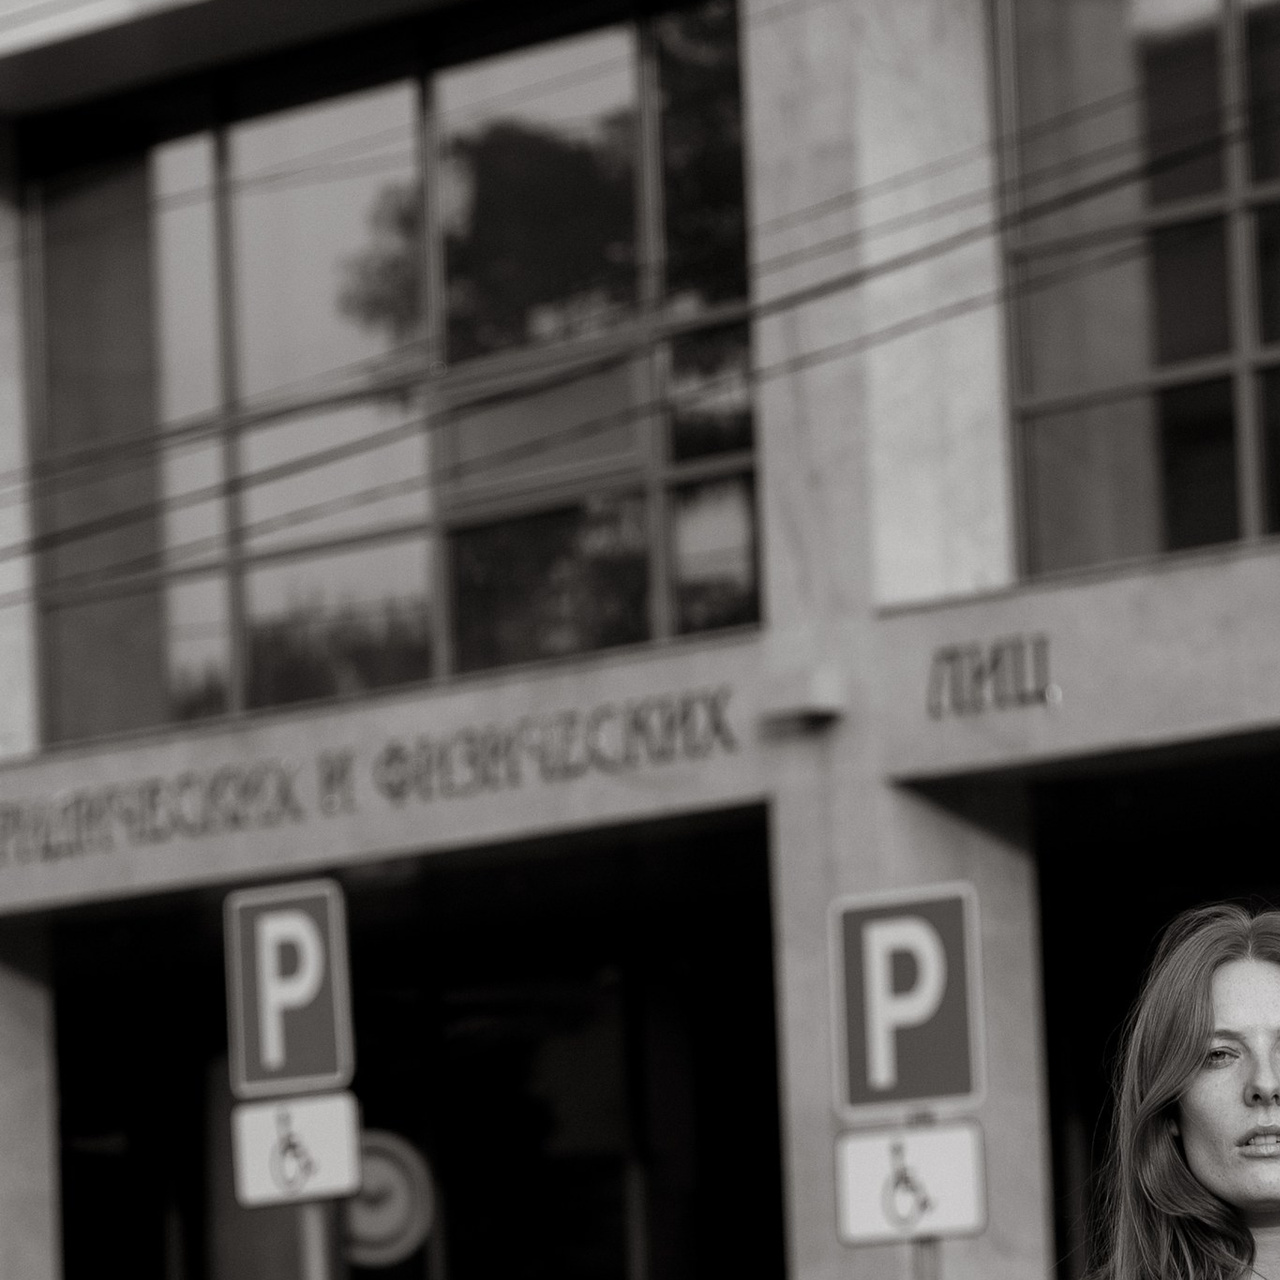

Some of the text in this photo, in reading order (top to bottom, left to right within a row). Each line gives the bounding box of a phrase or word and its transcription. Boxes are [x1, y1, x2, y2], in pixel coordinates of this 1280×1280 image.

[371, 683, 741, 810] ФИЗИЧЕСКИХ
[925, 631, 1053, 721] ЛИЦ
[254, 908, 326, 1072] P
[860, 915, 949, 1091] P
